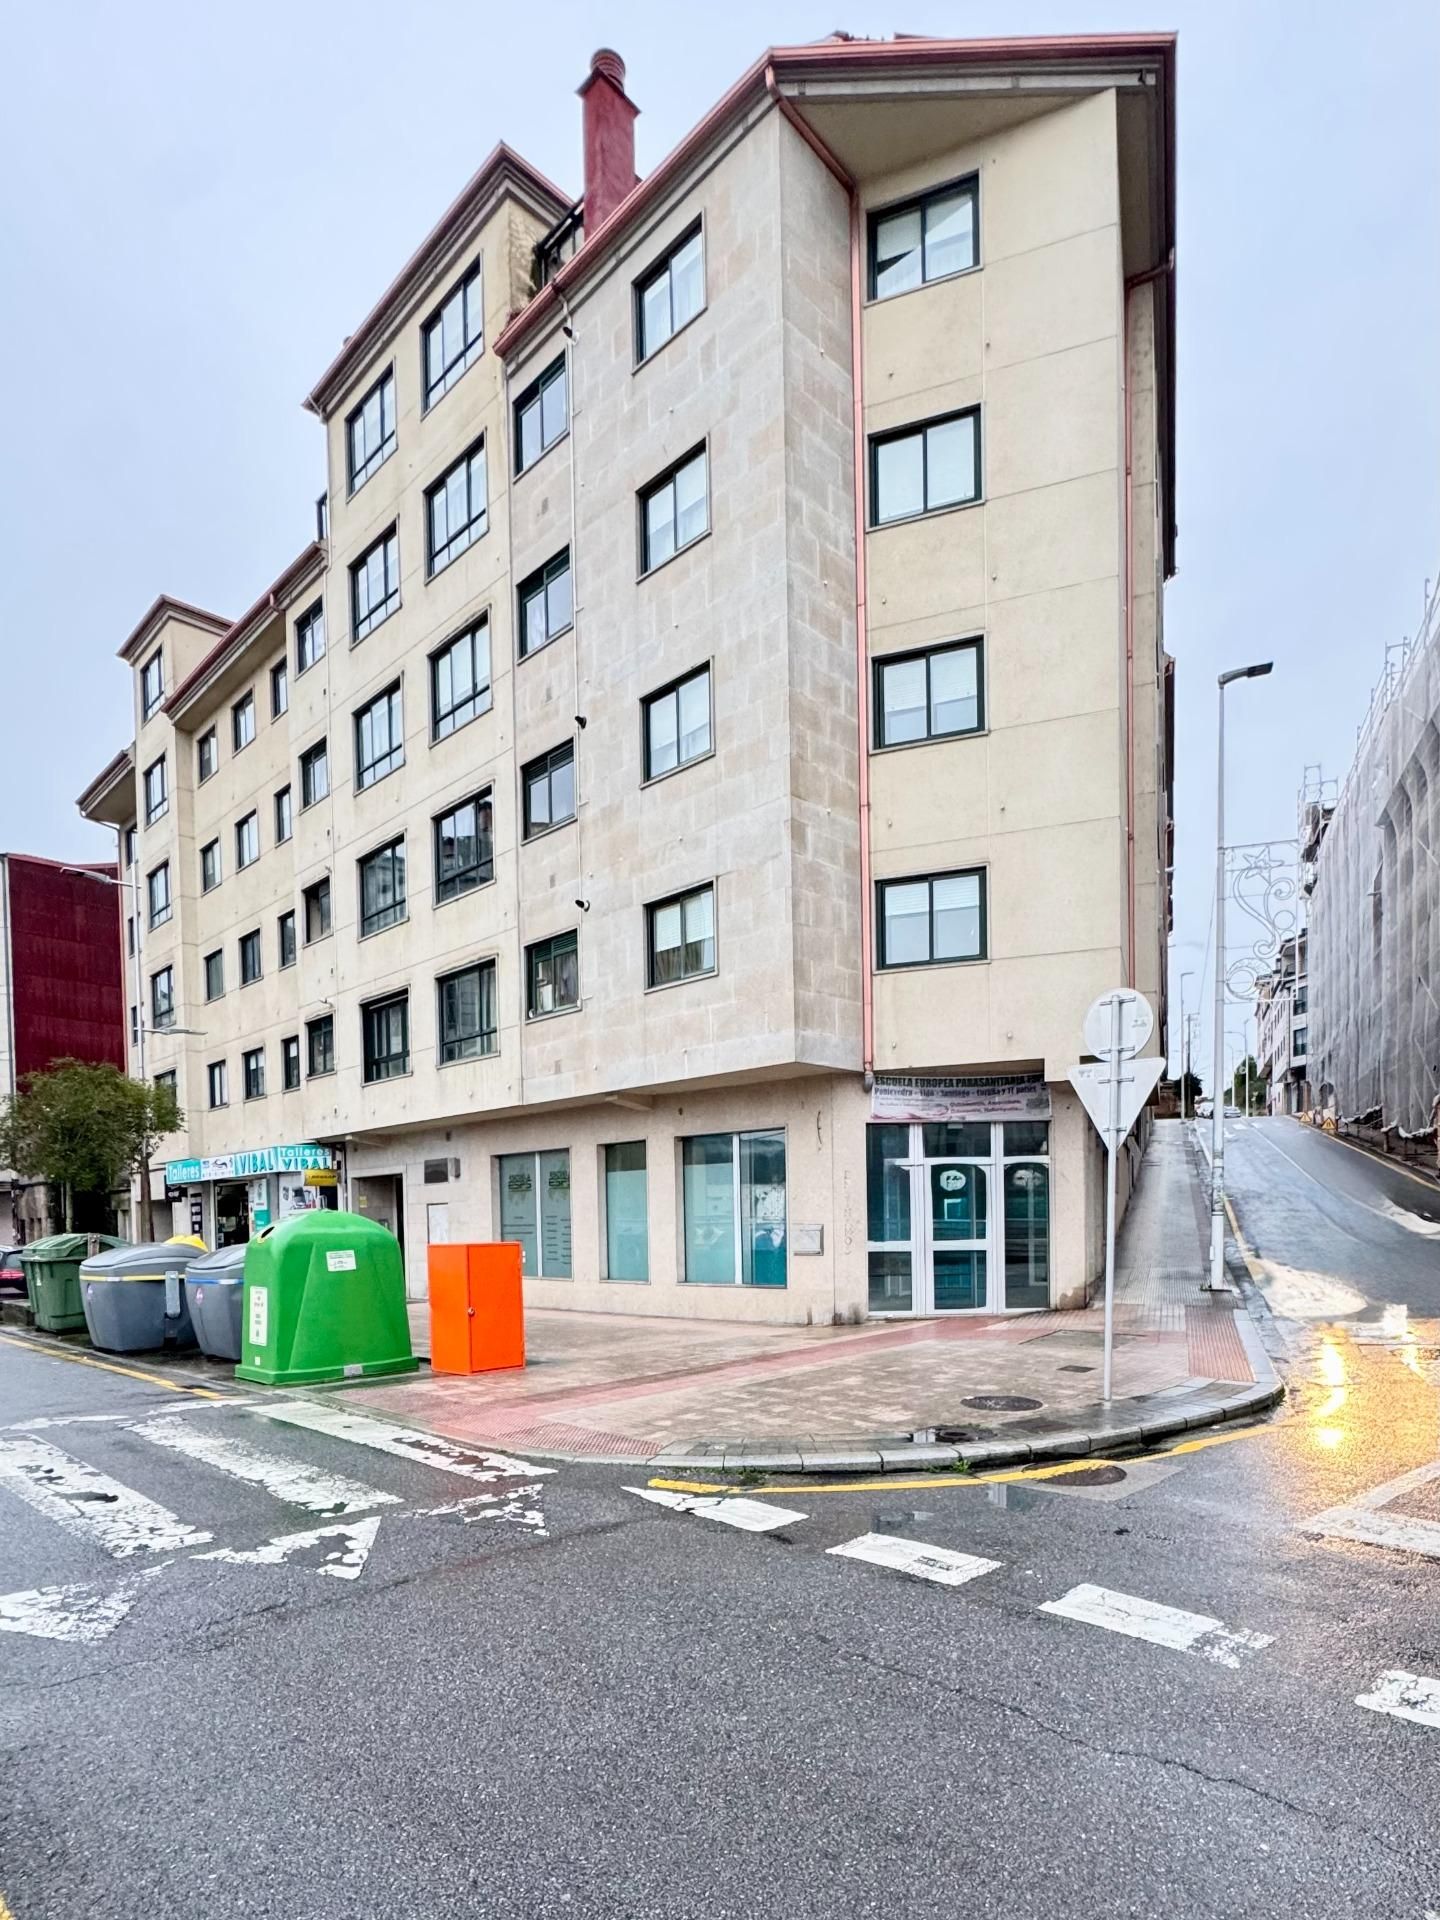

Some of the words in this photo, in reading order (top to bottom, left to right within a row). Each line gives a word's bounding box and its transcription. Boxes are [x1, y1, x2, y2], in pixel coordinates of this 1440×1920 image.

[875, 1076, 913, 1087] ESCUELA
[915, 1078, 954, 1088] EUROPEA
[956, 1076, 1025, 1088] PARASANITARIA
[281, 1147, 330, 1157] Talleres
[168, 1164, 200, 1181] Talleres
[239, 1151, 274, 1174] VIBAL
[282, 1157, 330, 1170] VIBAL
